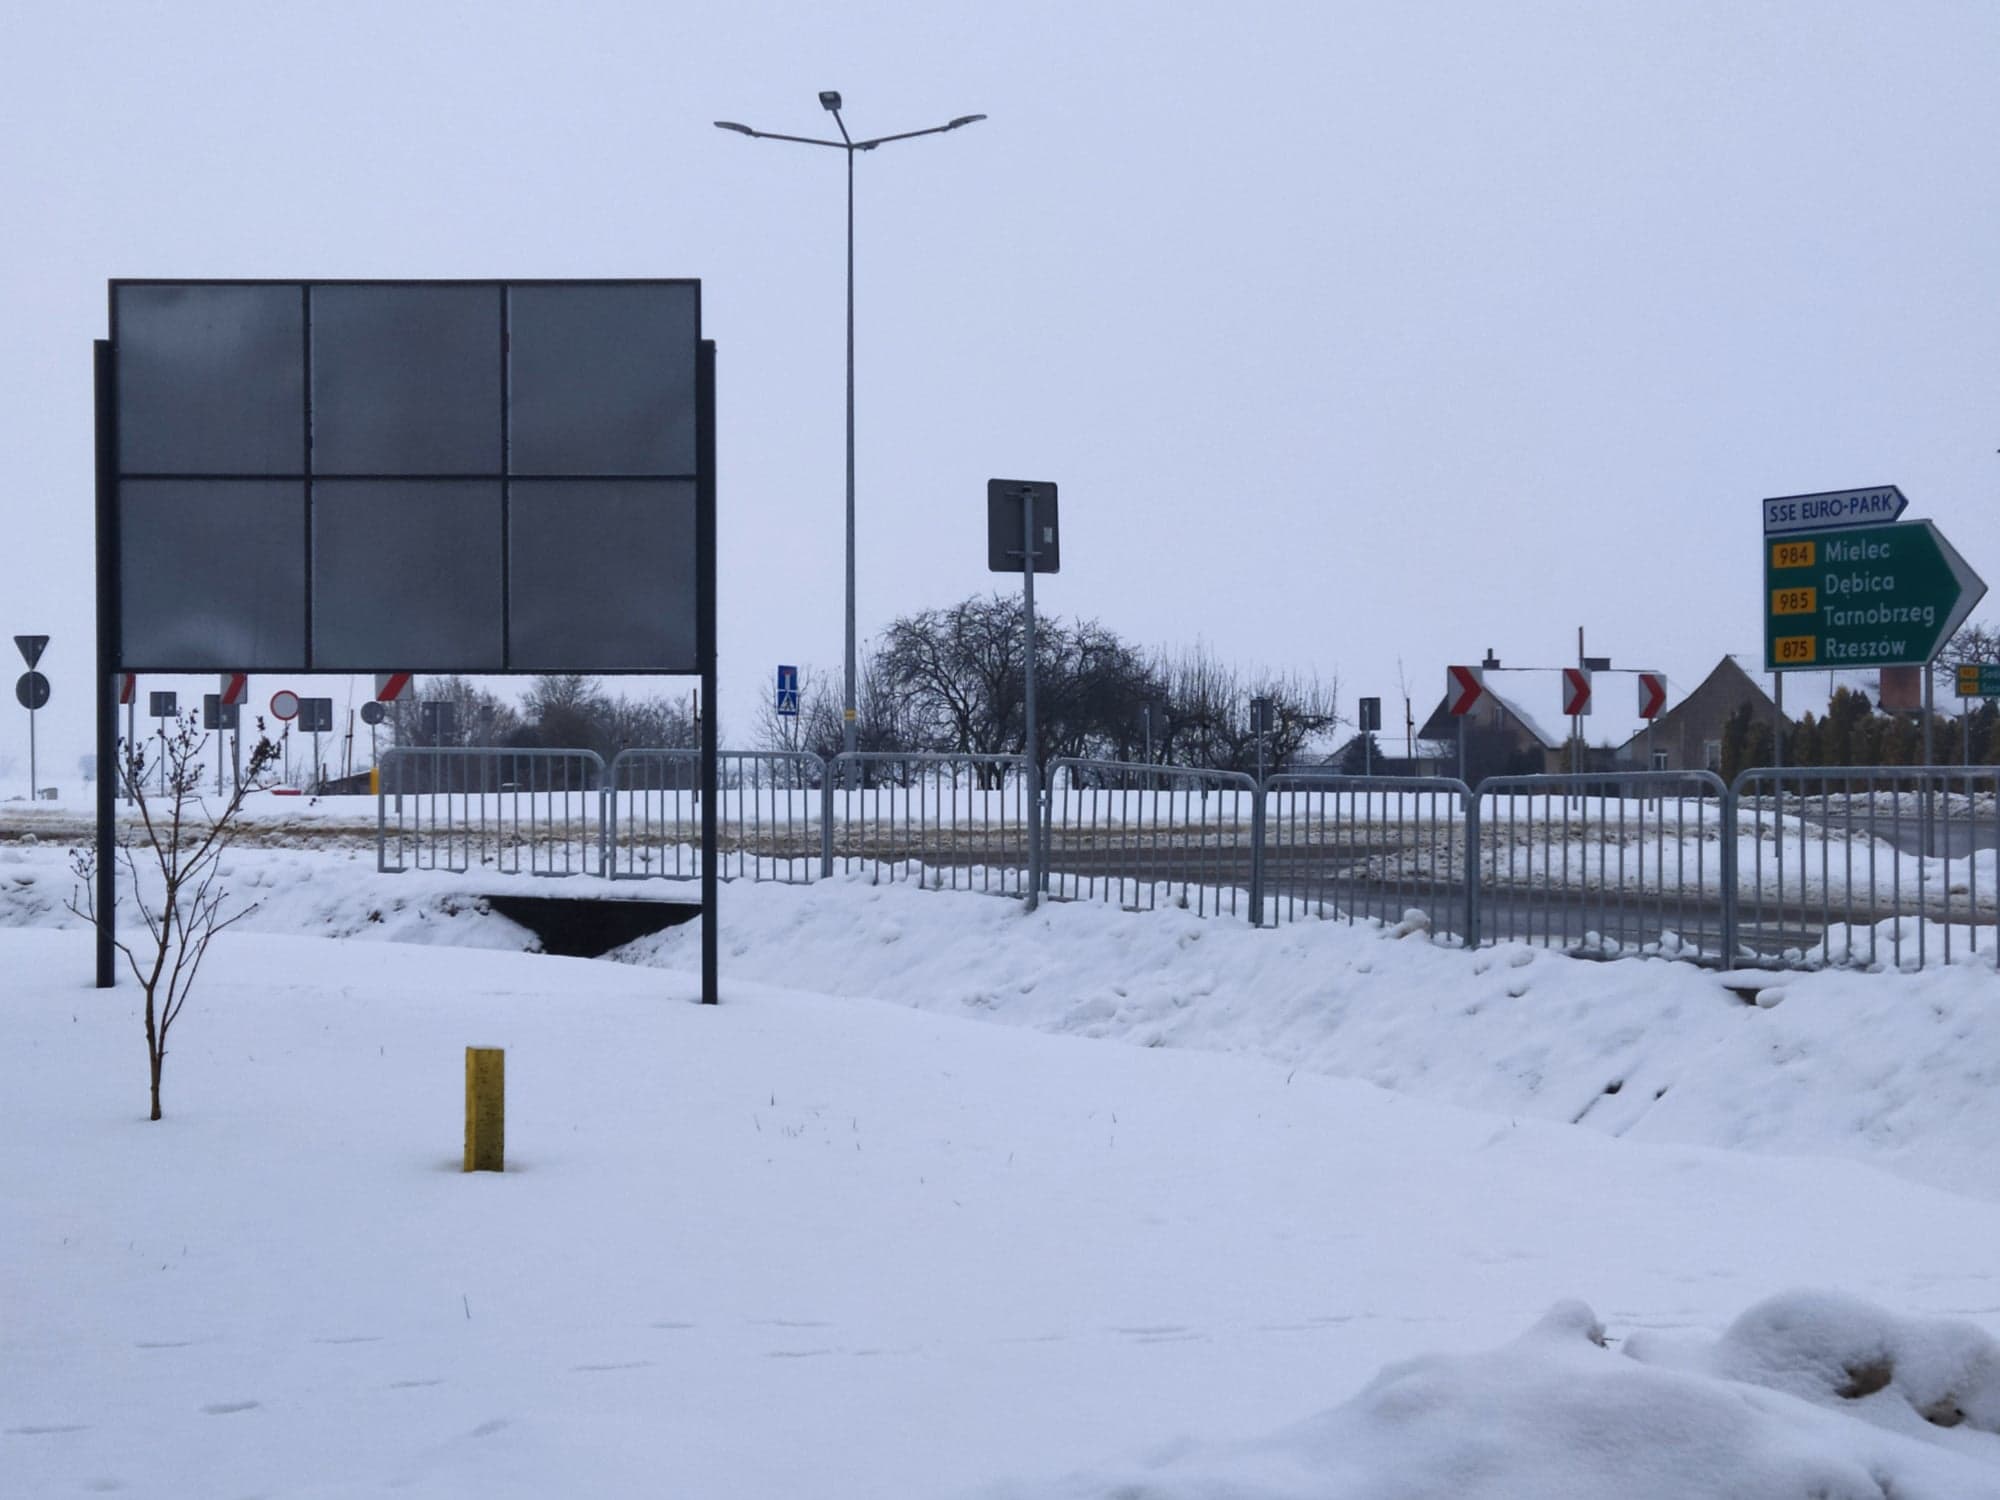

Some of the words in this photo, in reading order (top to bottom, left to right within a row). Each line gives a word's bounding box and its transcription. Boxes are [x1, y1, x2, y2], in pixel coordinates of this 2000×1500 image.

[1770, 503, 1796, 522] SSE
[1802, 493, 1893, 520] EURO-PARK
[1779, 546, 1808, 564] 984
[1825, 539, 1891, 563] Mielec
[1825, 572, 1895, 599] Dębica
[1780, 593, 1808, 611] 985
[1823, 603, 1935, 627] Tarnobrzeg
[1783, 641, 1808, 658] 875
[1825, 635, 1907, 658] Rzeszów
